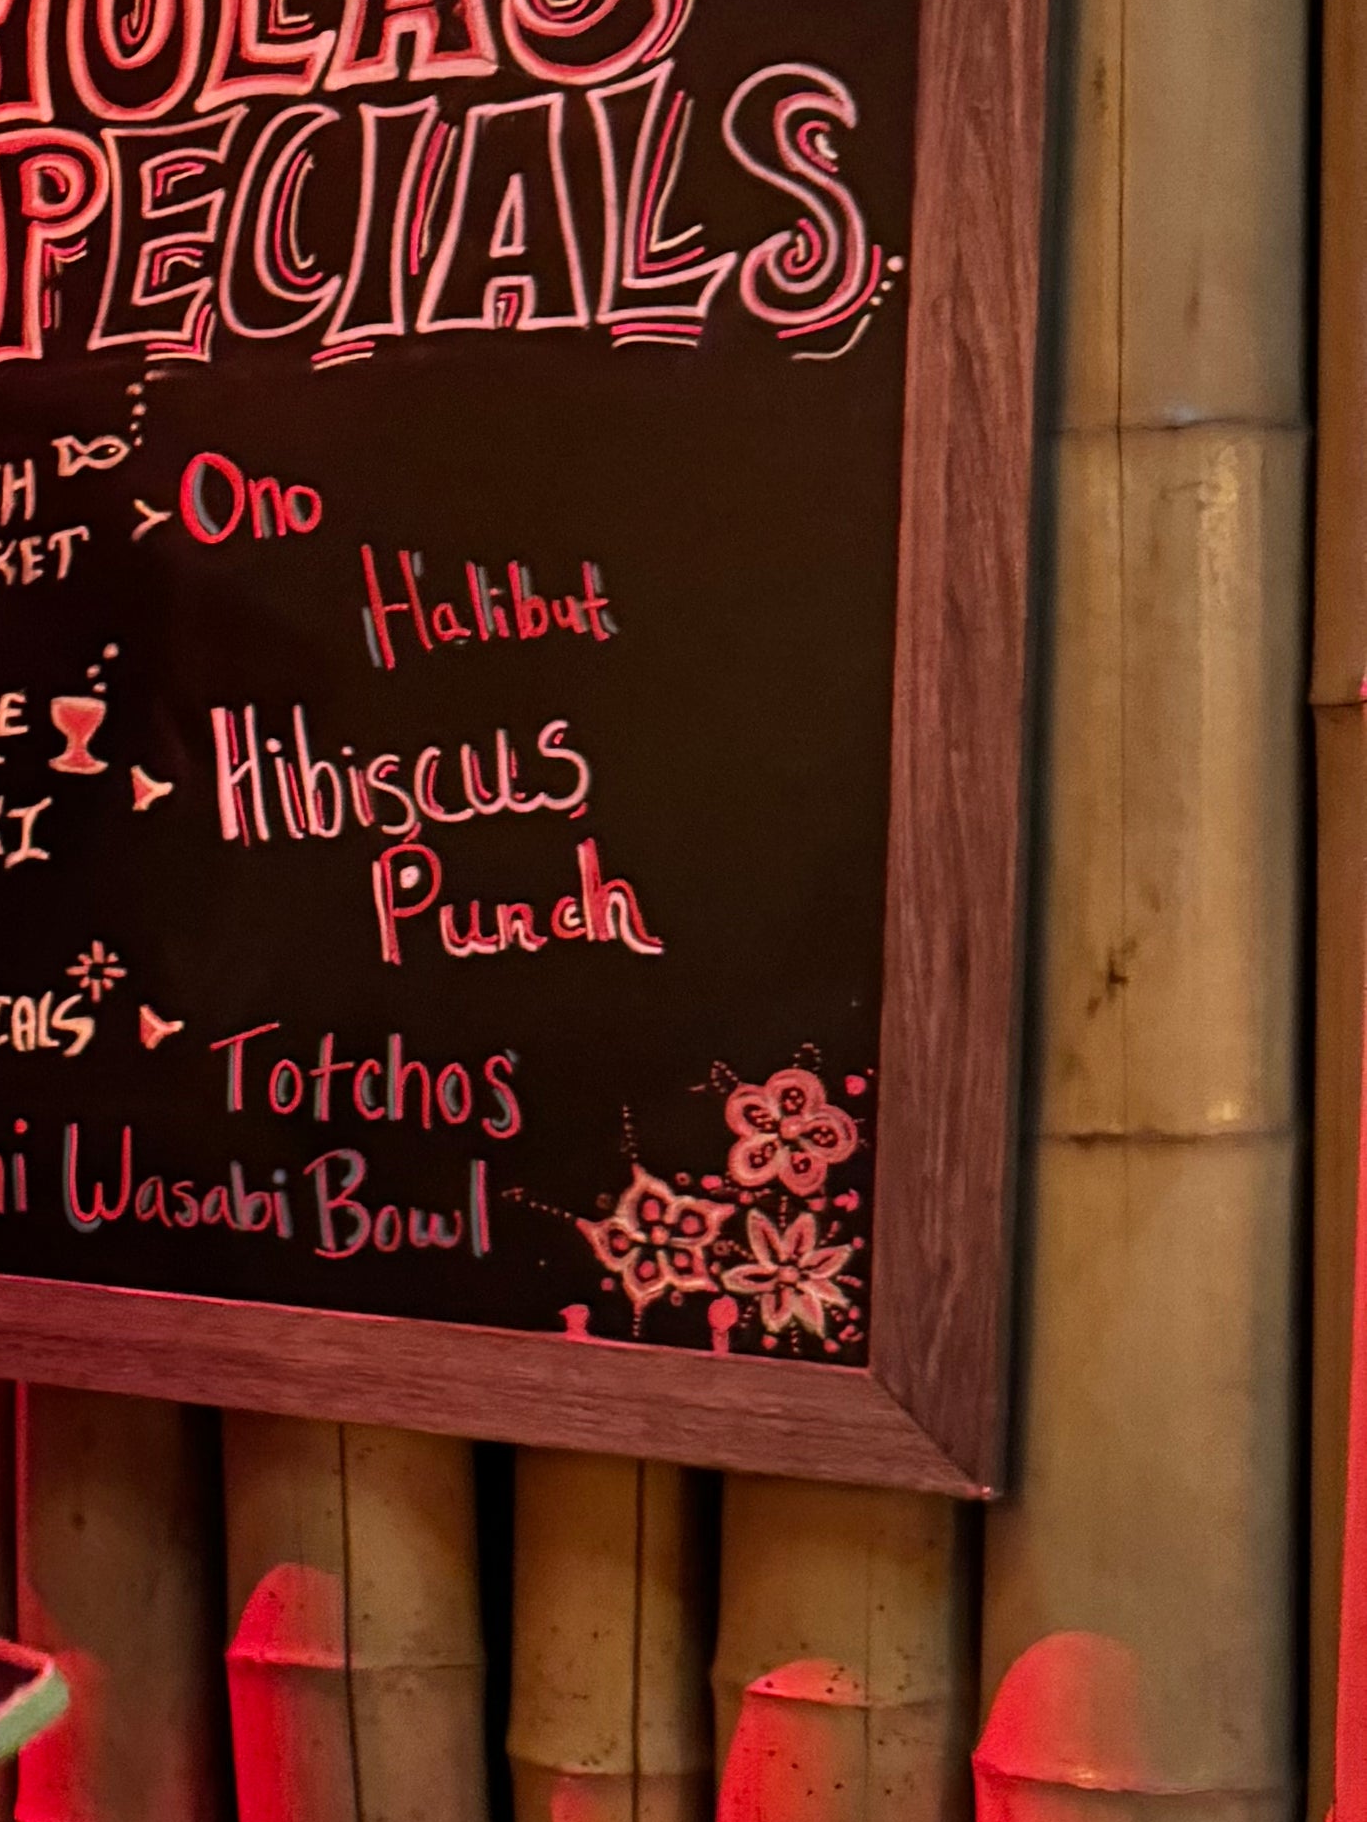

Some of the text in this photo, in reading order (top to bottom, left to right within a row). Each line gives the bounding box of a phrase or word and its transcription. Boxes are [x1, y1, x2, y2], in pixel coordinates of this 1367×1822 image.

[179, 452, 322, 544] Ono
[362, 544, 619, 671] Halibut
[210, 704, 594, 848] Hibiscus
[371, 838, 665, 966] Punch
[209, 1020, 522, 1139] Totchos
[66, 1120, 293, 1234] Wasabi
[313, 1148, 491, 1260] Bowl
